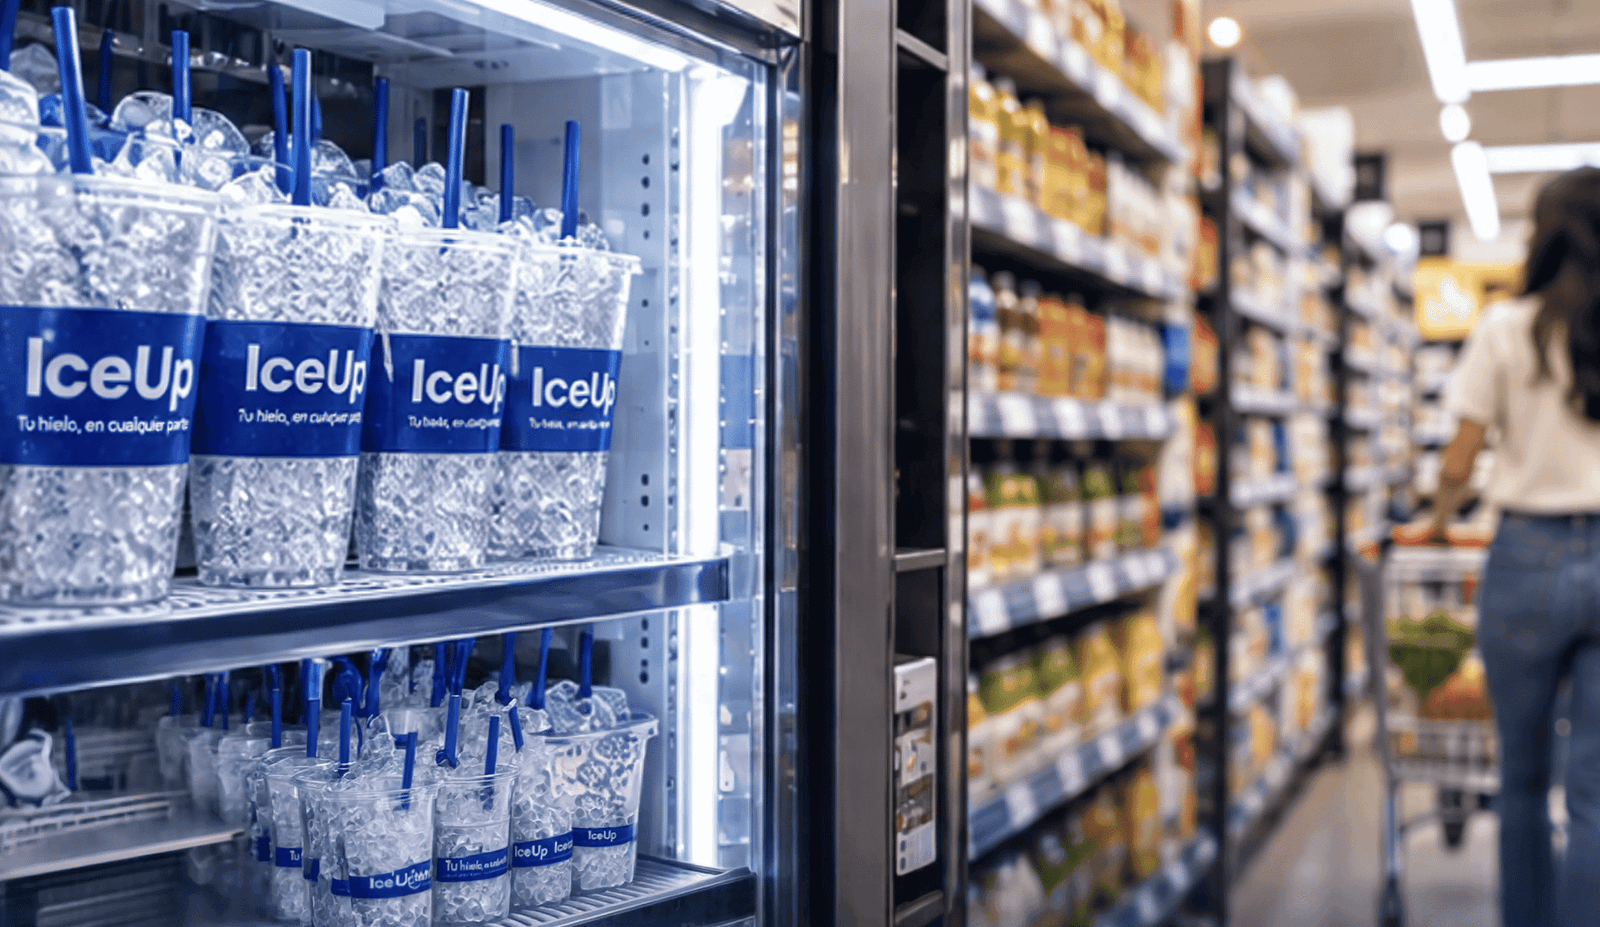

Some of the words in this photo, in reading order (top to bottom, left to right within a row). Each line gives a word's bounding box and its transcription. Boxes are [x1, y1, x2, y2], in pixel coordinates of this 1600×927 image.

[26, 337, 193, 412] IceUp
[245, 343, 367, 404] IceUp
[412, 358, 506, 414] IceUp
[532, 367, 615, 416] IceUp
[17, 414, 36, 432] Tu
[38, 414, 82, 435] hielo,
[84, 420, 104, 432] en
[107, 415, 165, 436] cualquier
[238, 408, 254, 423] Tu
[587, 830, 617, 842] IceUp
[289, 850, 300, 861] Tu
[514, 844, 548, 860] IceUp
[445, 859, 458, 871] Tu
